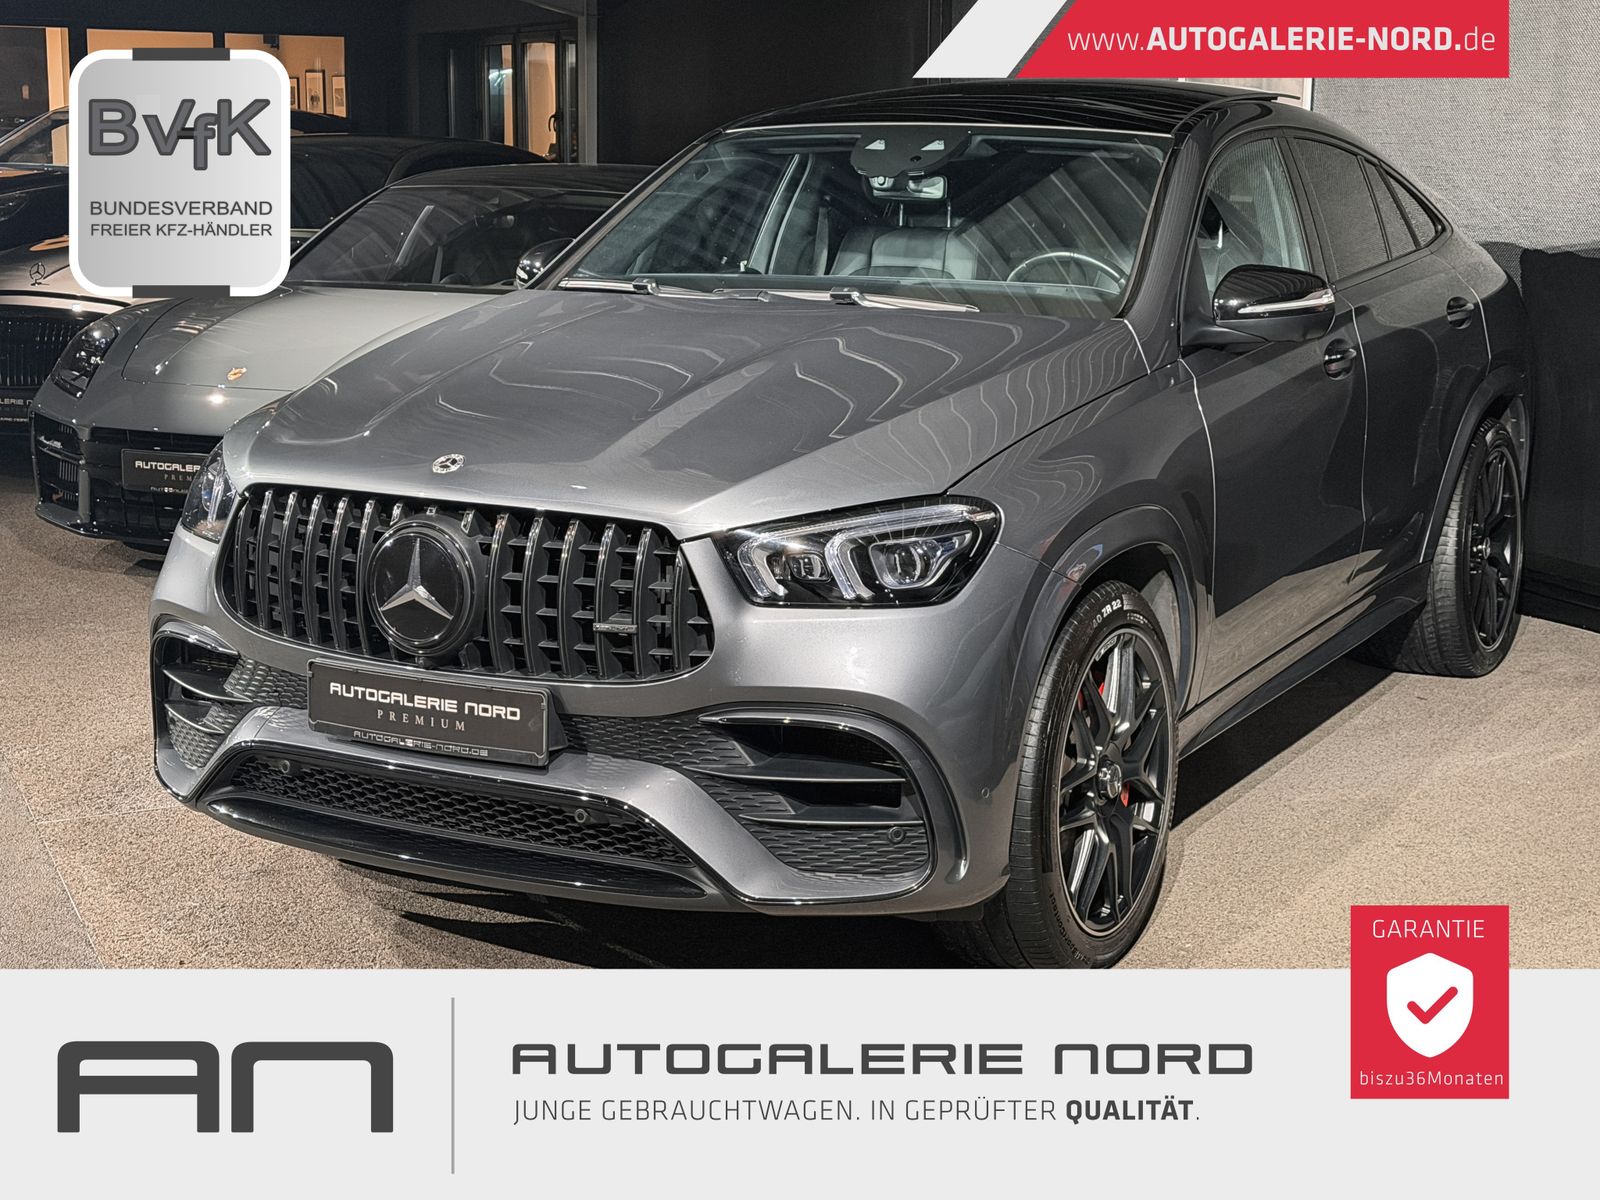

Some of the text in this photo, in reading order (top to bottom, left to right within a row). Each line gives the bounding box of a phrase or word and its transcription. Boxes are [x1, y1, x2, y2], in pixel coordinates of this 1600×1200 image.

[1101, 604, 1113, 618] ZR
[1111, 599, 1122, 610] 22
[329, 682, 521, 721] AUTOGALERIE NORD
[376, 709, 466, 732] PREMIUM
